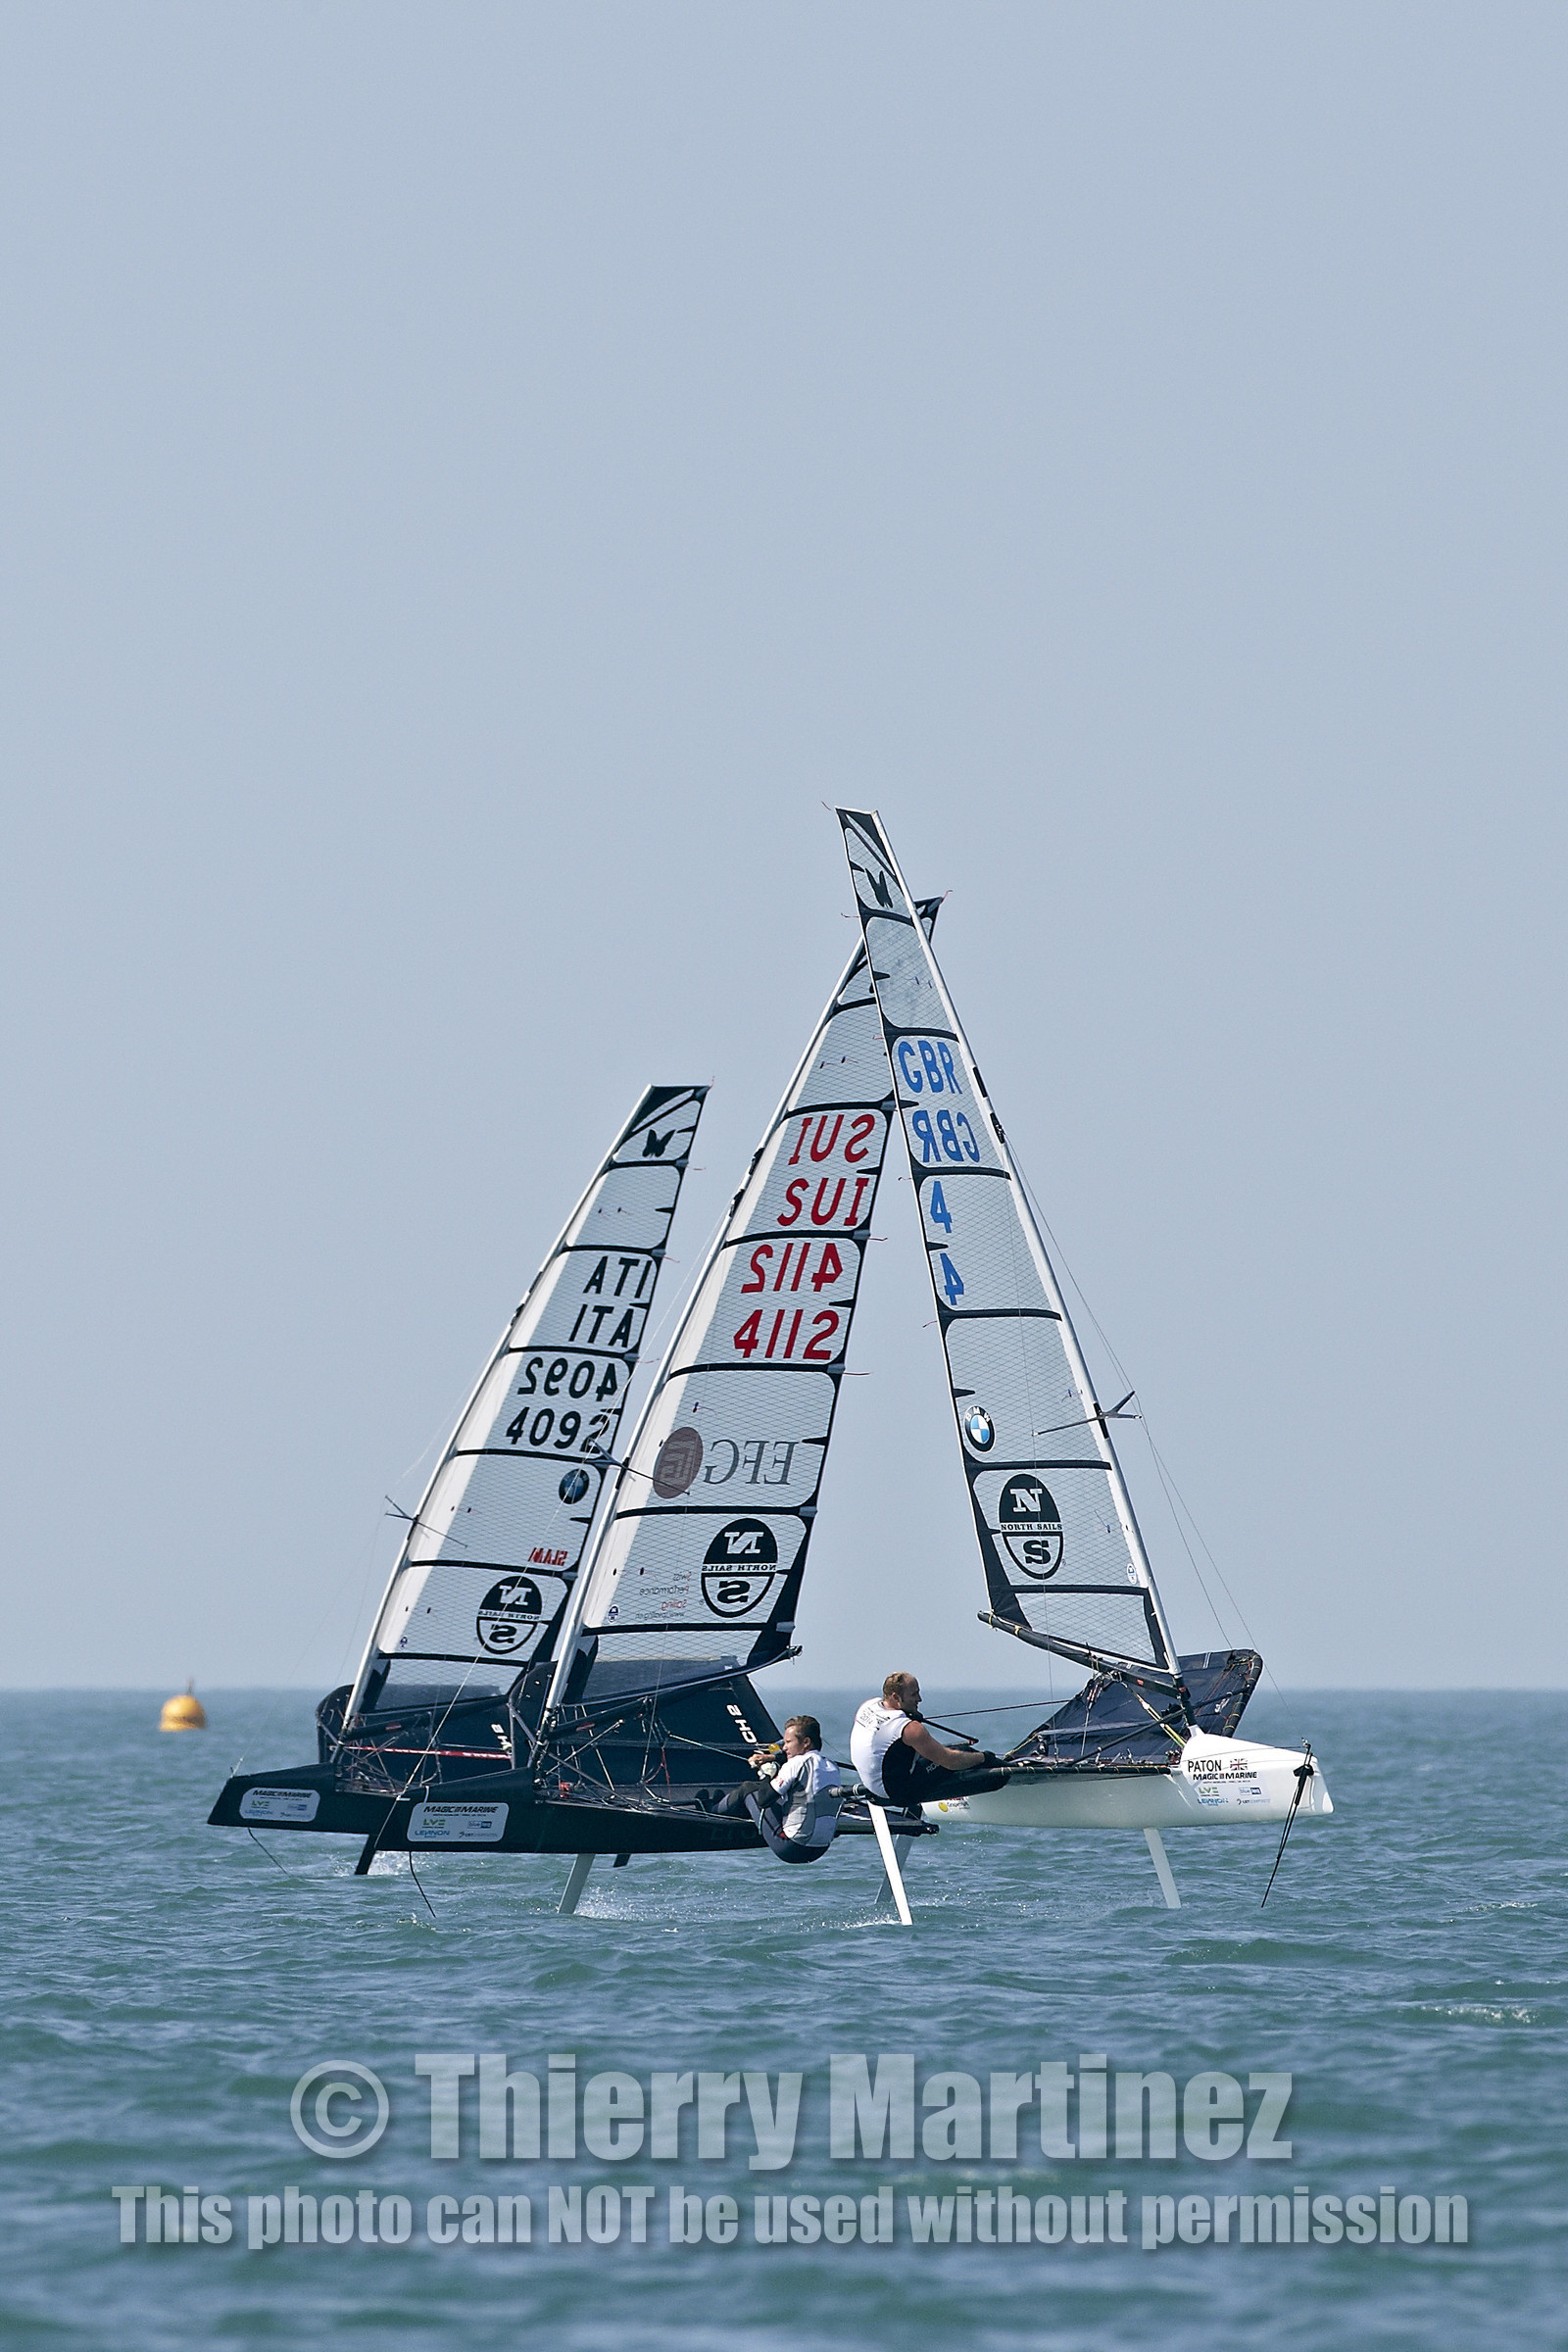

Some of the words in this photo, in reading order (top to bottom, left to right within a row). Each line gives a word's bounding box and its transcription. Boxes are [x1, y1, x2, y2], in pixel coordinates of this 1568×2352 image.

[898, 1040, 962, 1094] GBR
[776, 1178, 869, 1226] SUI
[930, 1180, 953, 1234] 4
[568, 1303, 634, 1348] ITA
[733, 1309, 839, 1360] 4112
[506, 1406, 611, 1454] 4092
[1009, 1488, 1043, 1512] N
[1023, 1540, 1051, 1564] S
[1187, 1759, 1222, 1773] PATON
